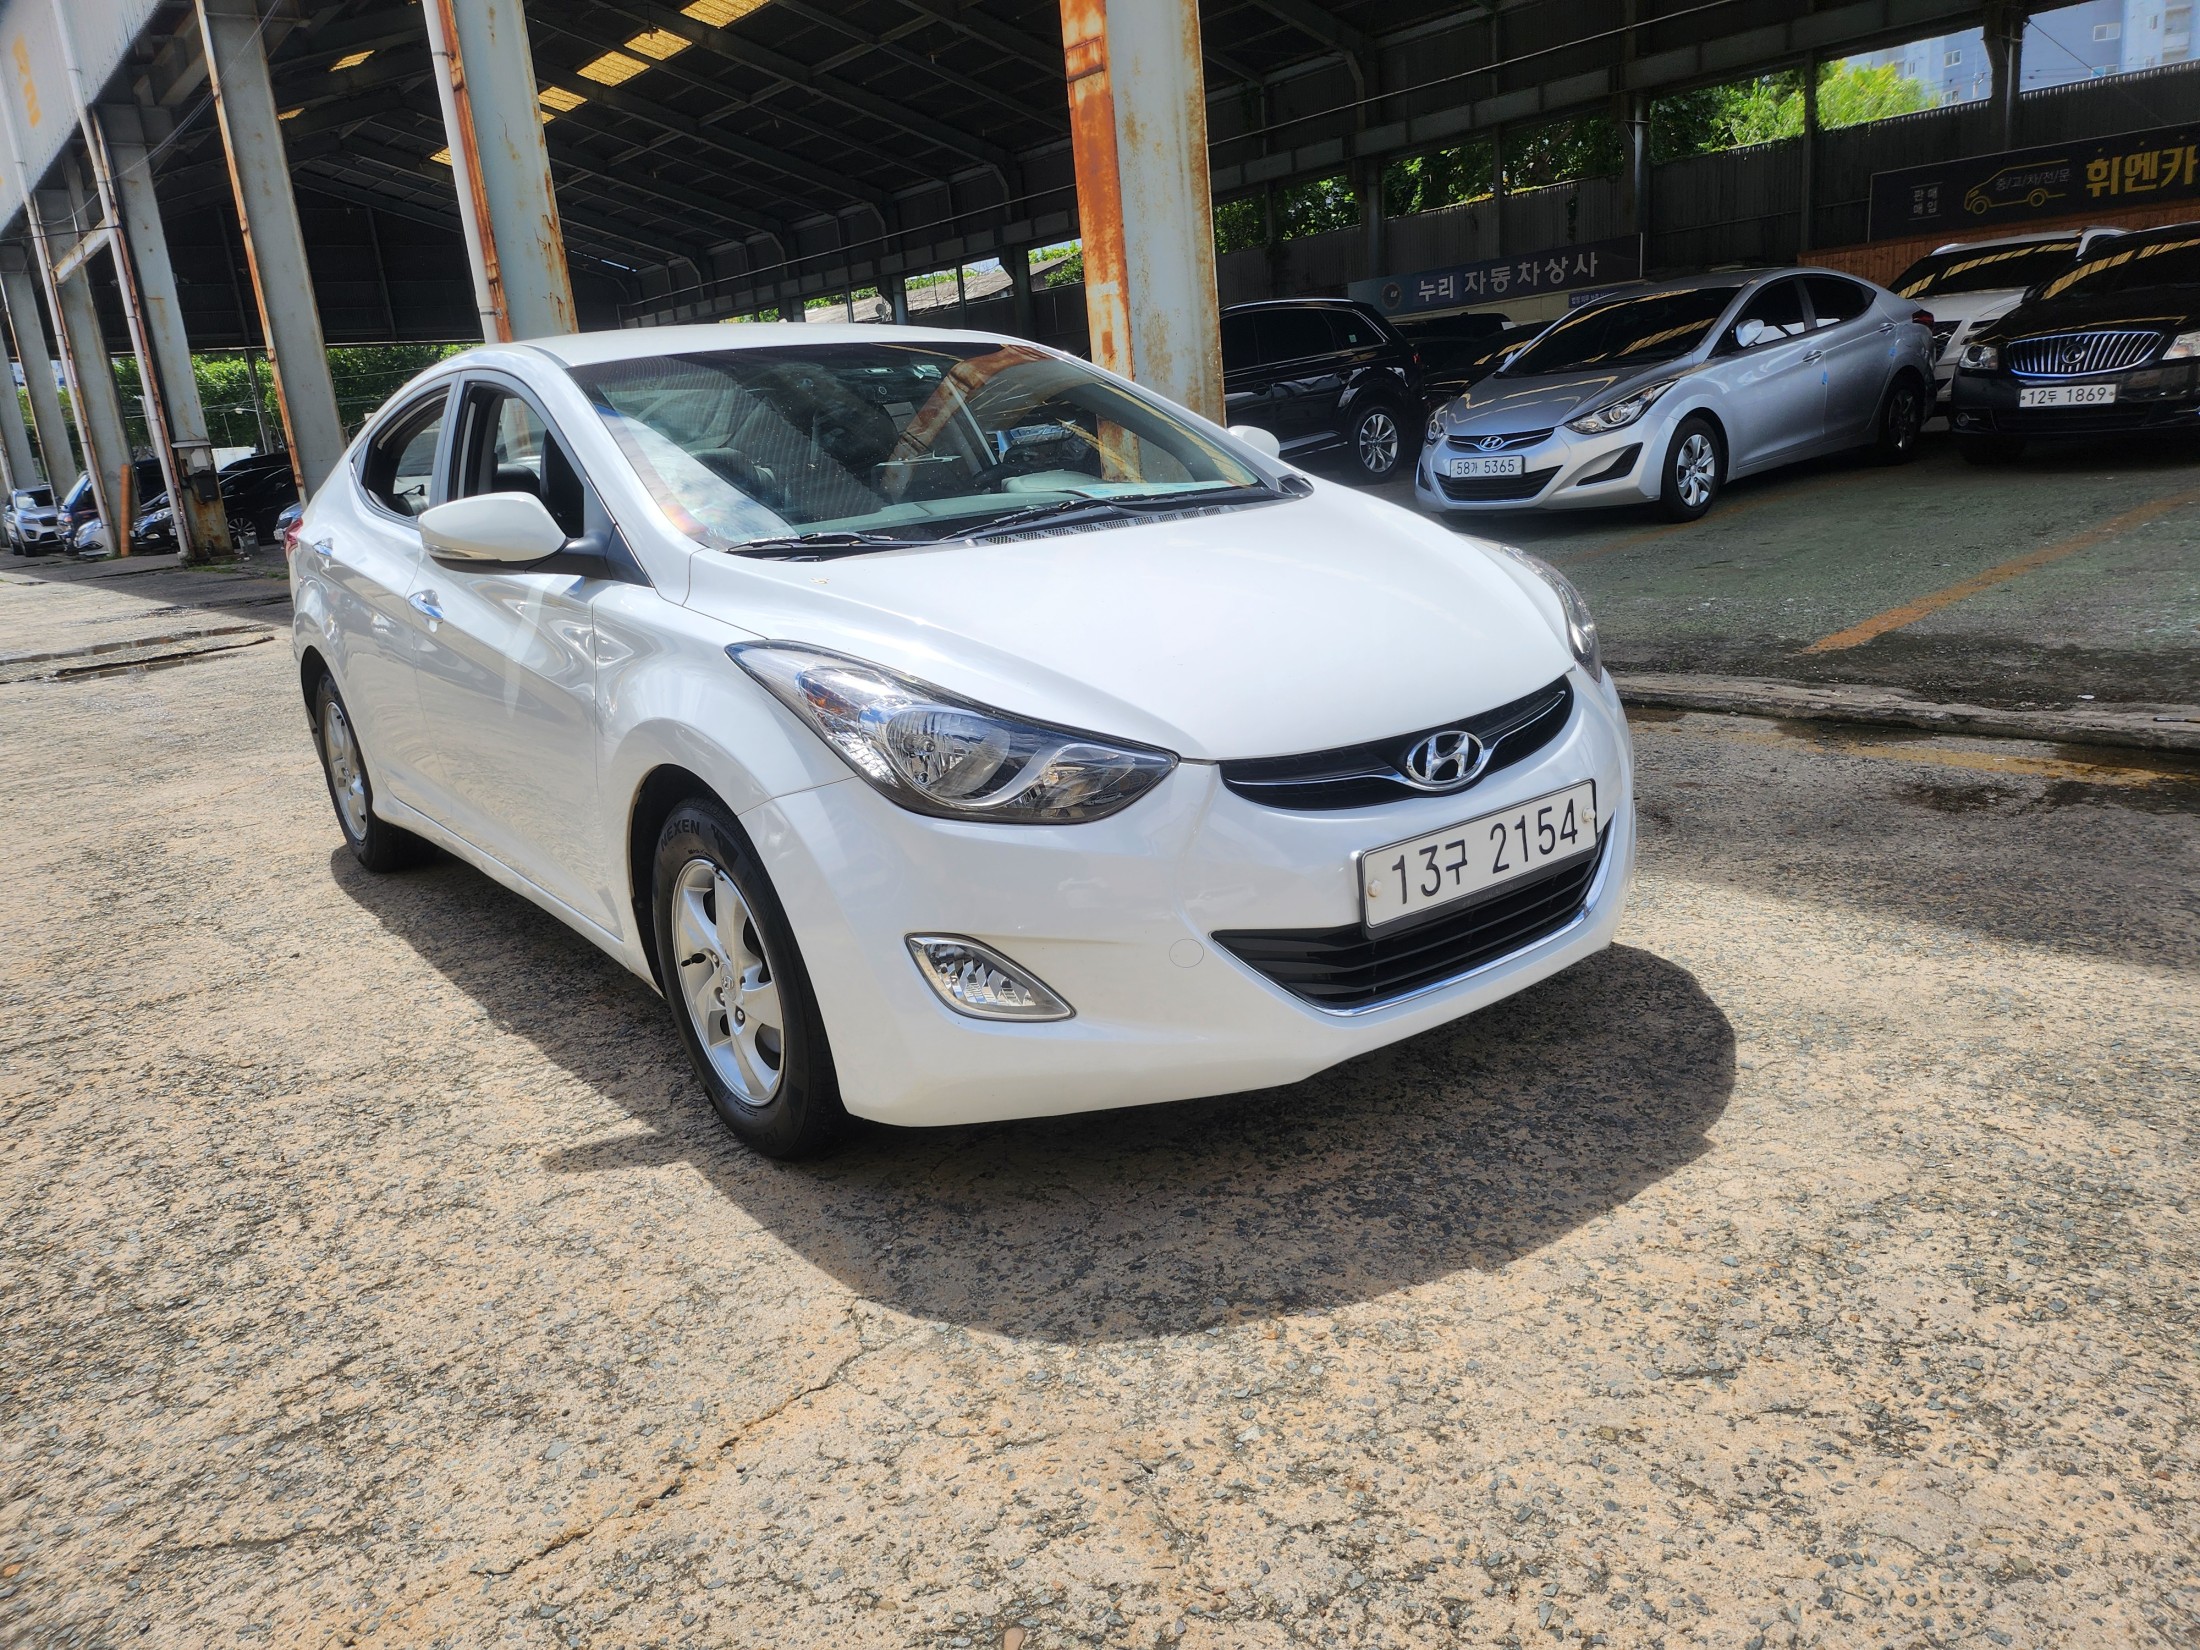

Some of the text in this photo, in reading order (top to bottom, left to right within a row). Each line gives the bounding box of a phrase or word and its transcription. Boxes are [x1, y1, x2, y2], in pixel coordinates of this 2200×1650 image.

[2086, 145, 2198, 197] 휘엔카
[1419, 252, 1598, 301] 누리 자동차상사
[2029, 387, 2106, 404] 12두 1869
[1456, 459, 1514, 475] 58가 5365
[660, 818, 700, 852] NEXEN
[1392, 798, 1578, 904] 13구 2154
